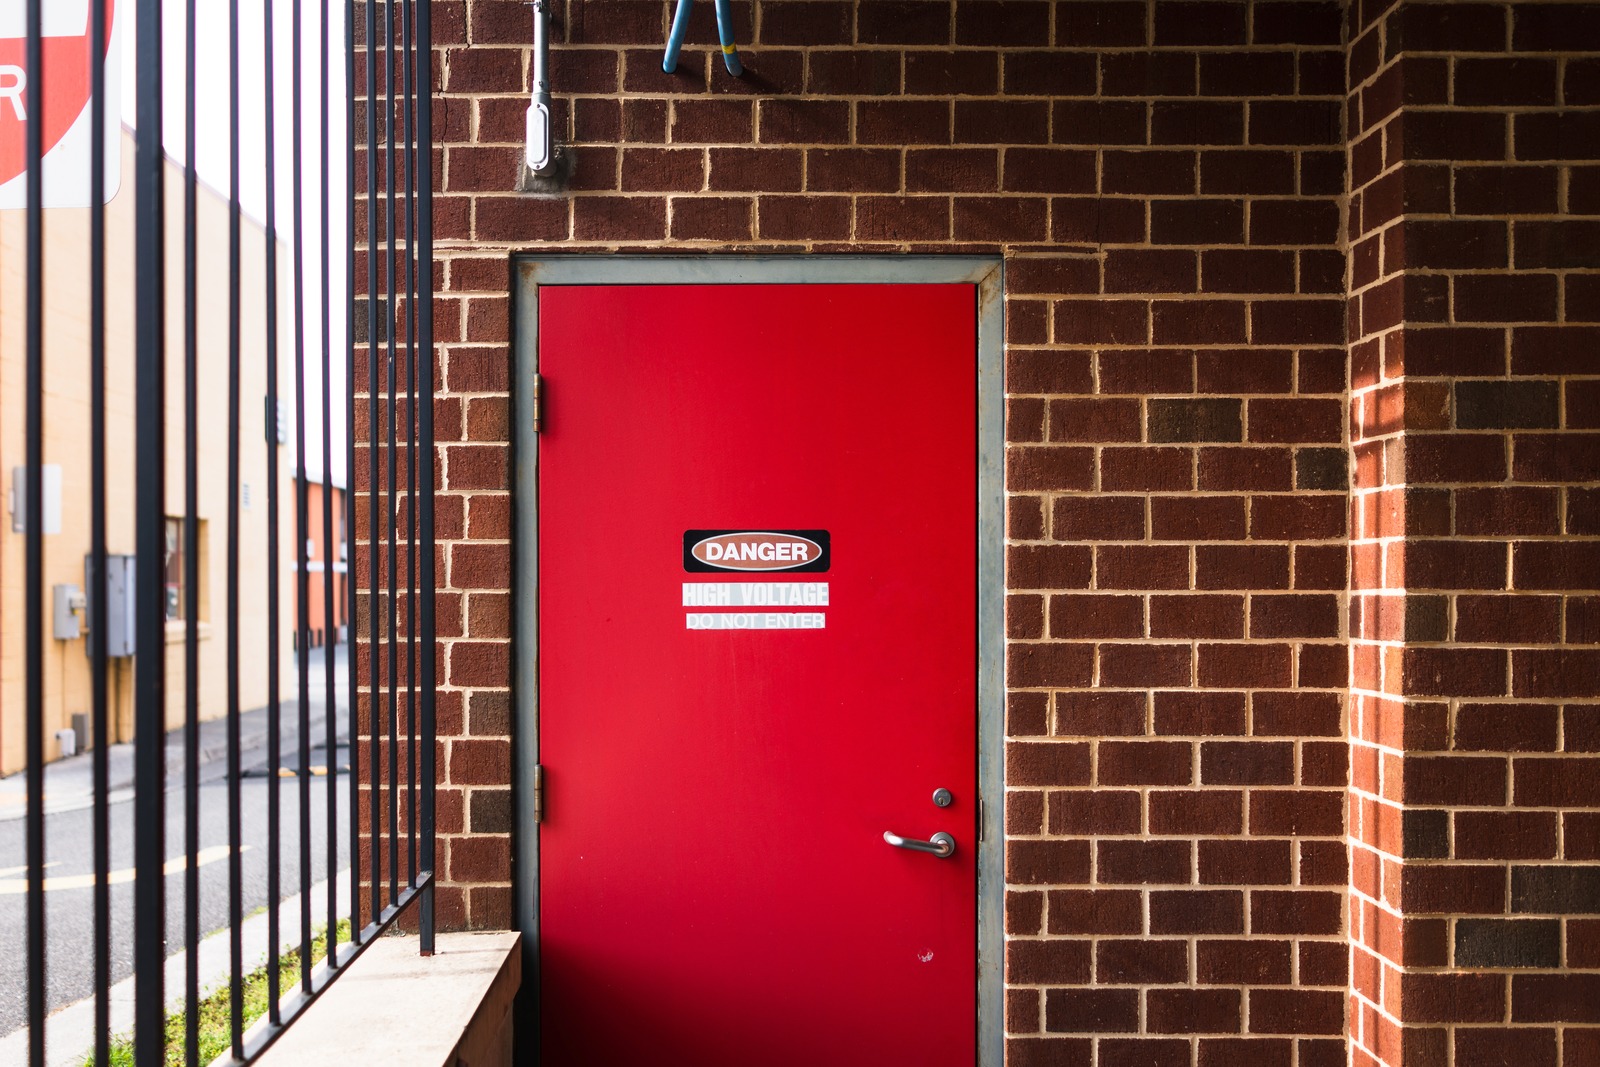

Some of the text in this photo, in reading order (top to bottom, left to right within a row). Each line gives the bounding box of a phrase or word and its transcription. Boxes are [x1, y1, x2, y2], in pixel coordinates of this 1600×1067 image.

[706, 542, 808, 561] DANGER
[684, 583, 829, 606] HIGH VOLTAGE
[688, 613, 825, 629] DO NOT ENTER
